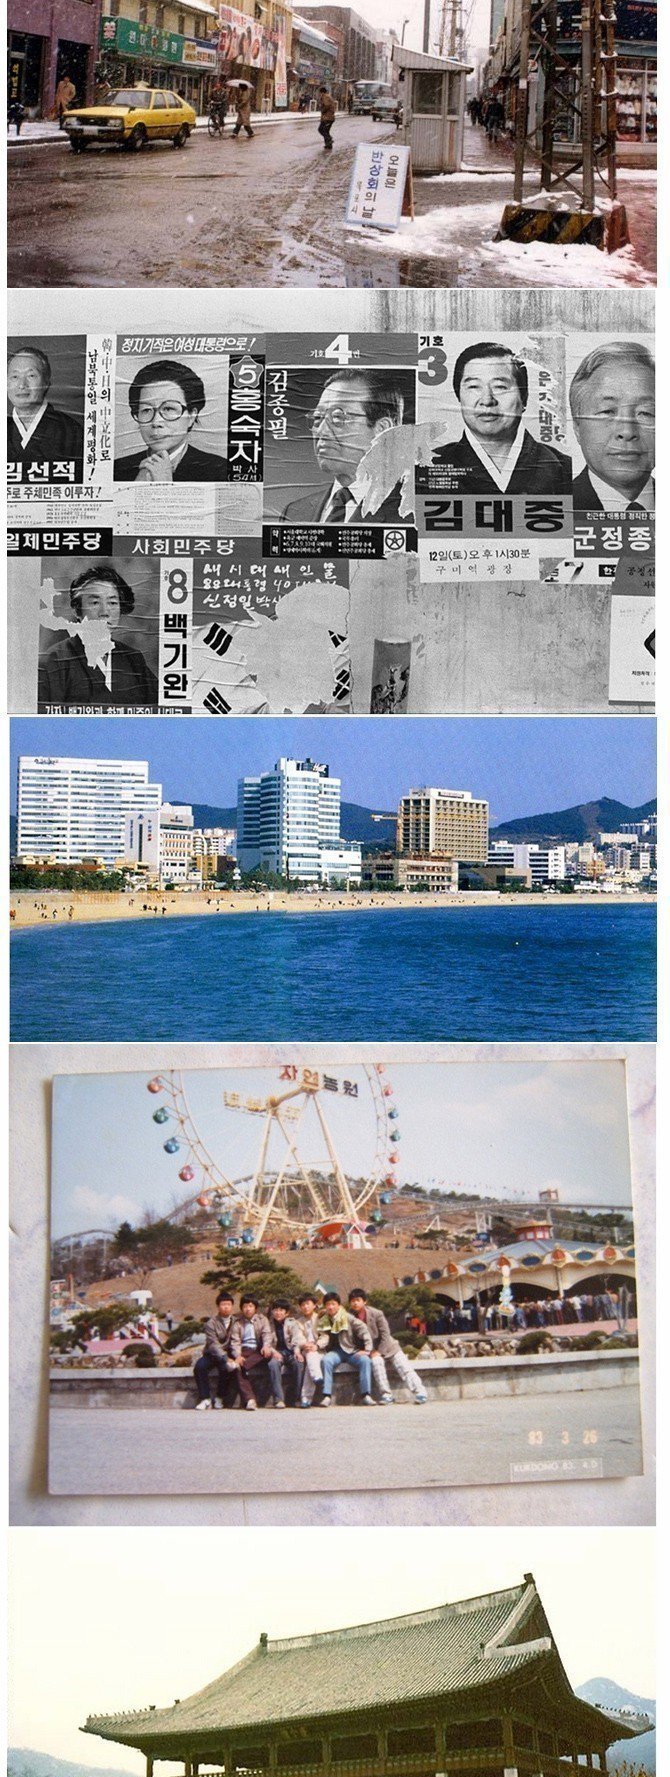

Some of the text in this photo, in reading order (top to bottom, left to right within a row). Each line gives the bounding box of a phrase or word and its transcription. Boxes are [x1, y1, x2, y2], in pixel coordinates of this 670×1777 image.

[385, 155, 399, 189] 오늘은
[420, 336, 444, 347] 기호
[87, 350, 98, 405] 남북통일
[238, 364, 258, 384] 5
[418, 348, 448, 386] 3
[267, 370, 291, 440] 김종필
[228, 388, 262, 463] 홍숙자
[7, 460, 76, 483] 김선적
[232, 464, 258, 473] 박사
[24, 487, 62, 500] 주체민족
[424, 500, 565, 532] 김대중
[586, 512, 648, 520] 친근한 대통령 정직한
[132, 539, 235, 555] 사회민주당
[574, 526, 652, 551] 군정종
[429, 550, 468, 561] 12일(토)
[168, 568, 188, 604] 8
[163, 613, 189, 699] 백기완
[279, 1064, 359, 1098] 자연농원
